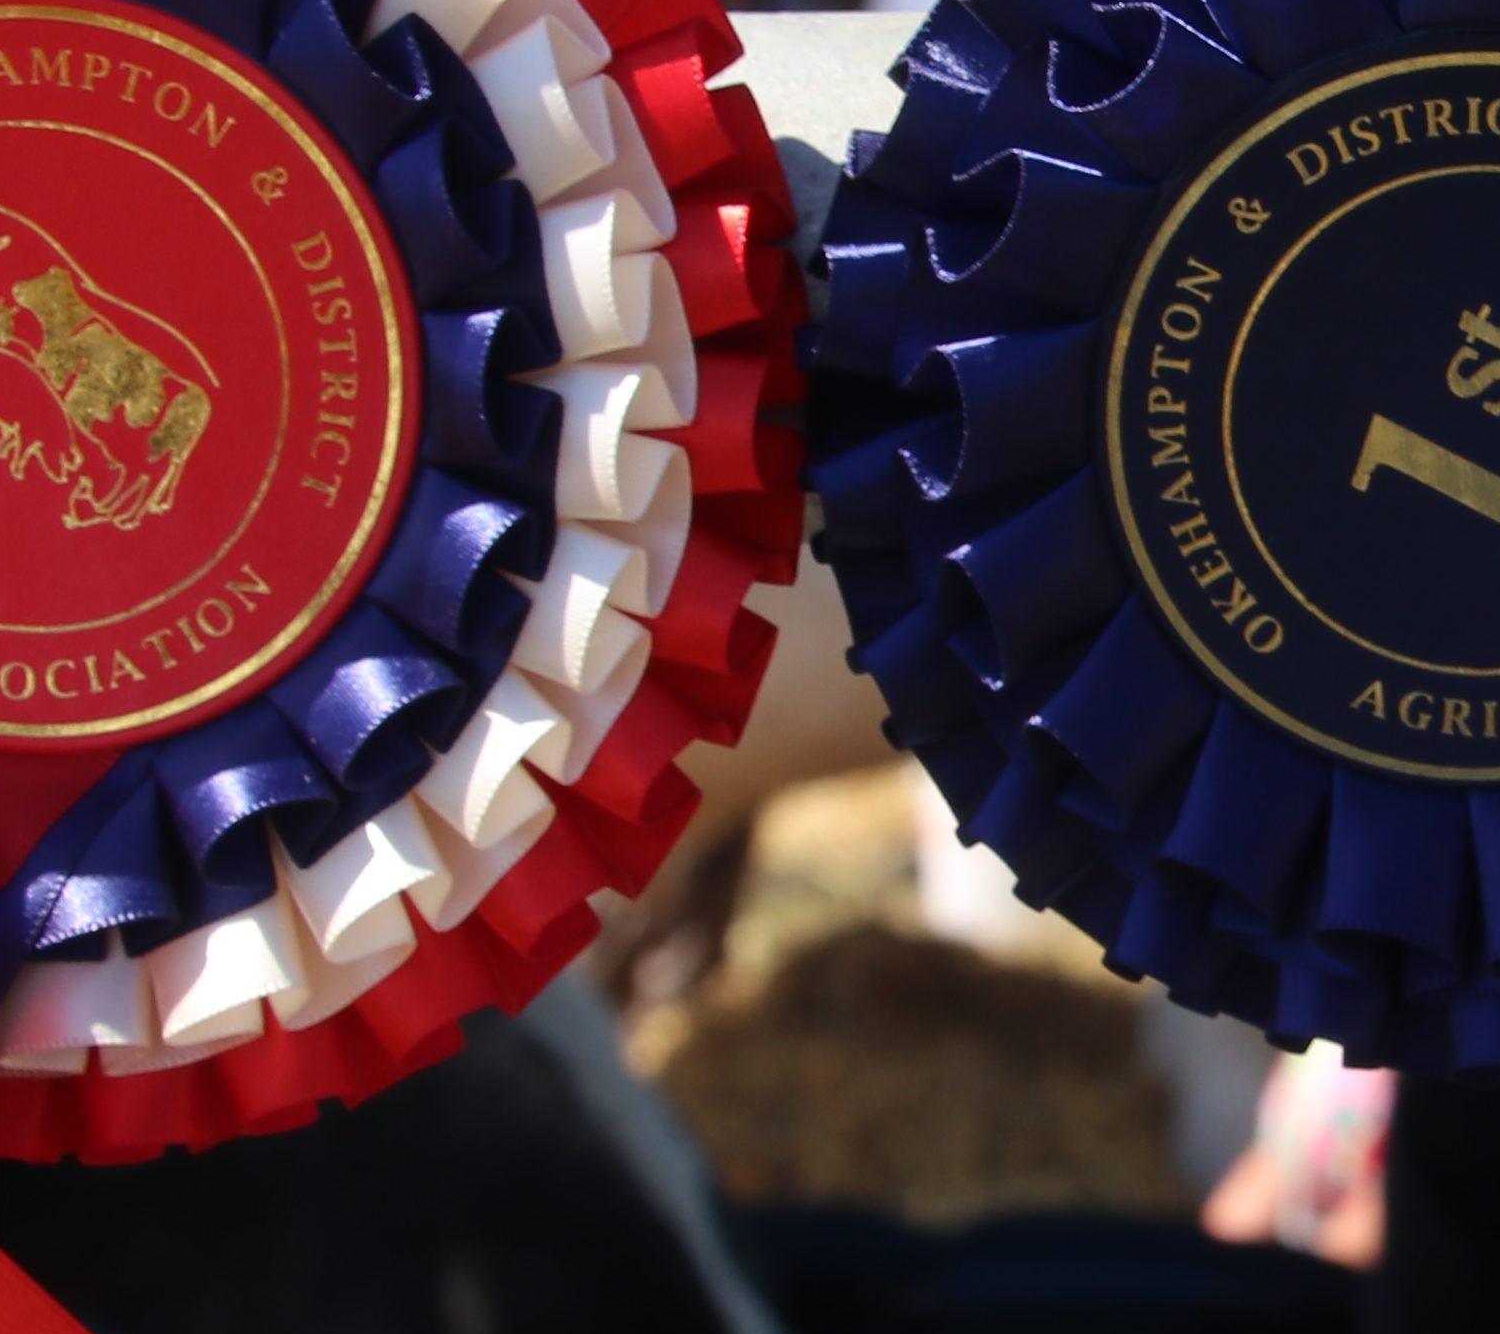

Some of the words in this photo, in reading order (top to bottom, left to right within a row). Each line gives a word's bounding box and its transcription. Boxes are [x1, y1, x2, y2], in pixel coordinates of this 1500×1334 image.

[251, 167, 286, 205] &
[293, 231, 359, 508] DISTRICT
[1148, 258, 1284, 653] OKEHAMPTON
[1228, 196, 1270, 234] &
